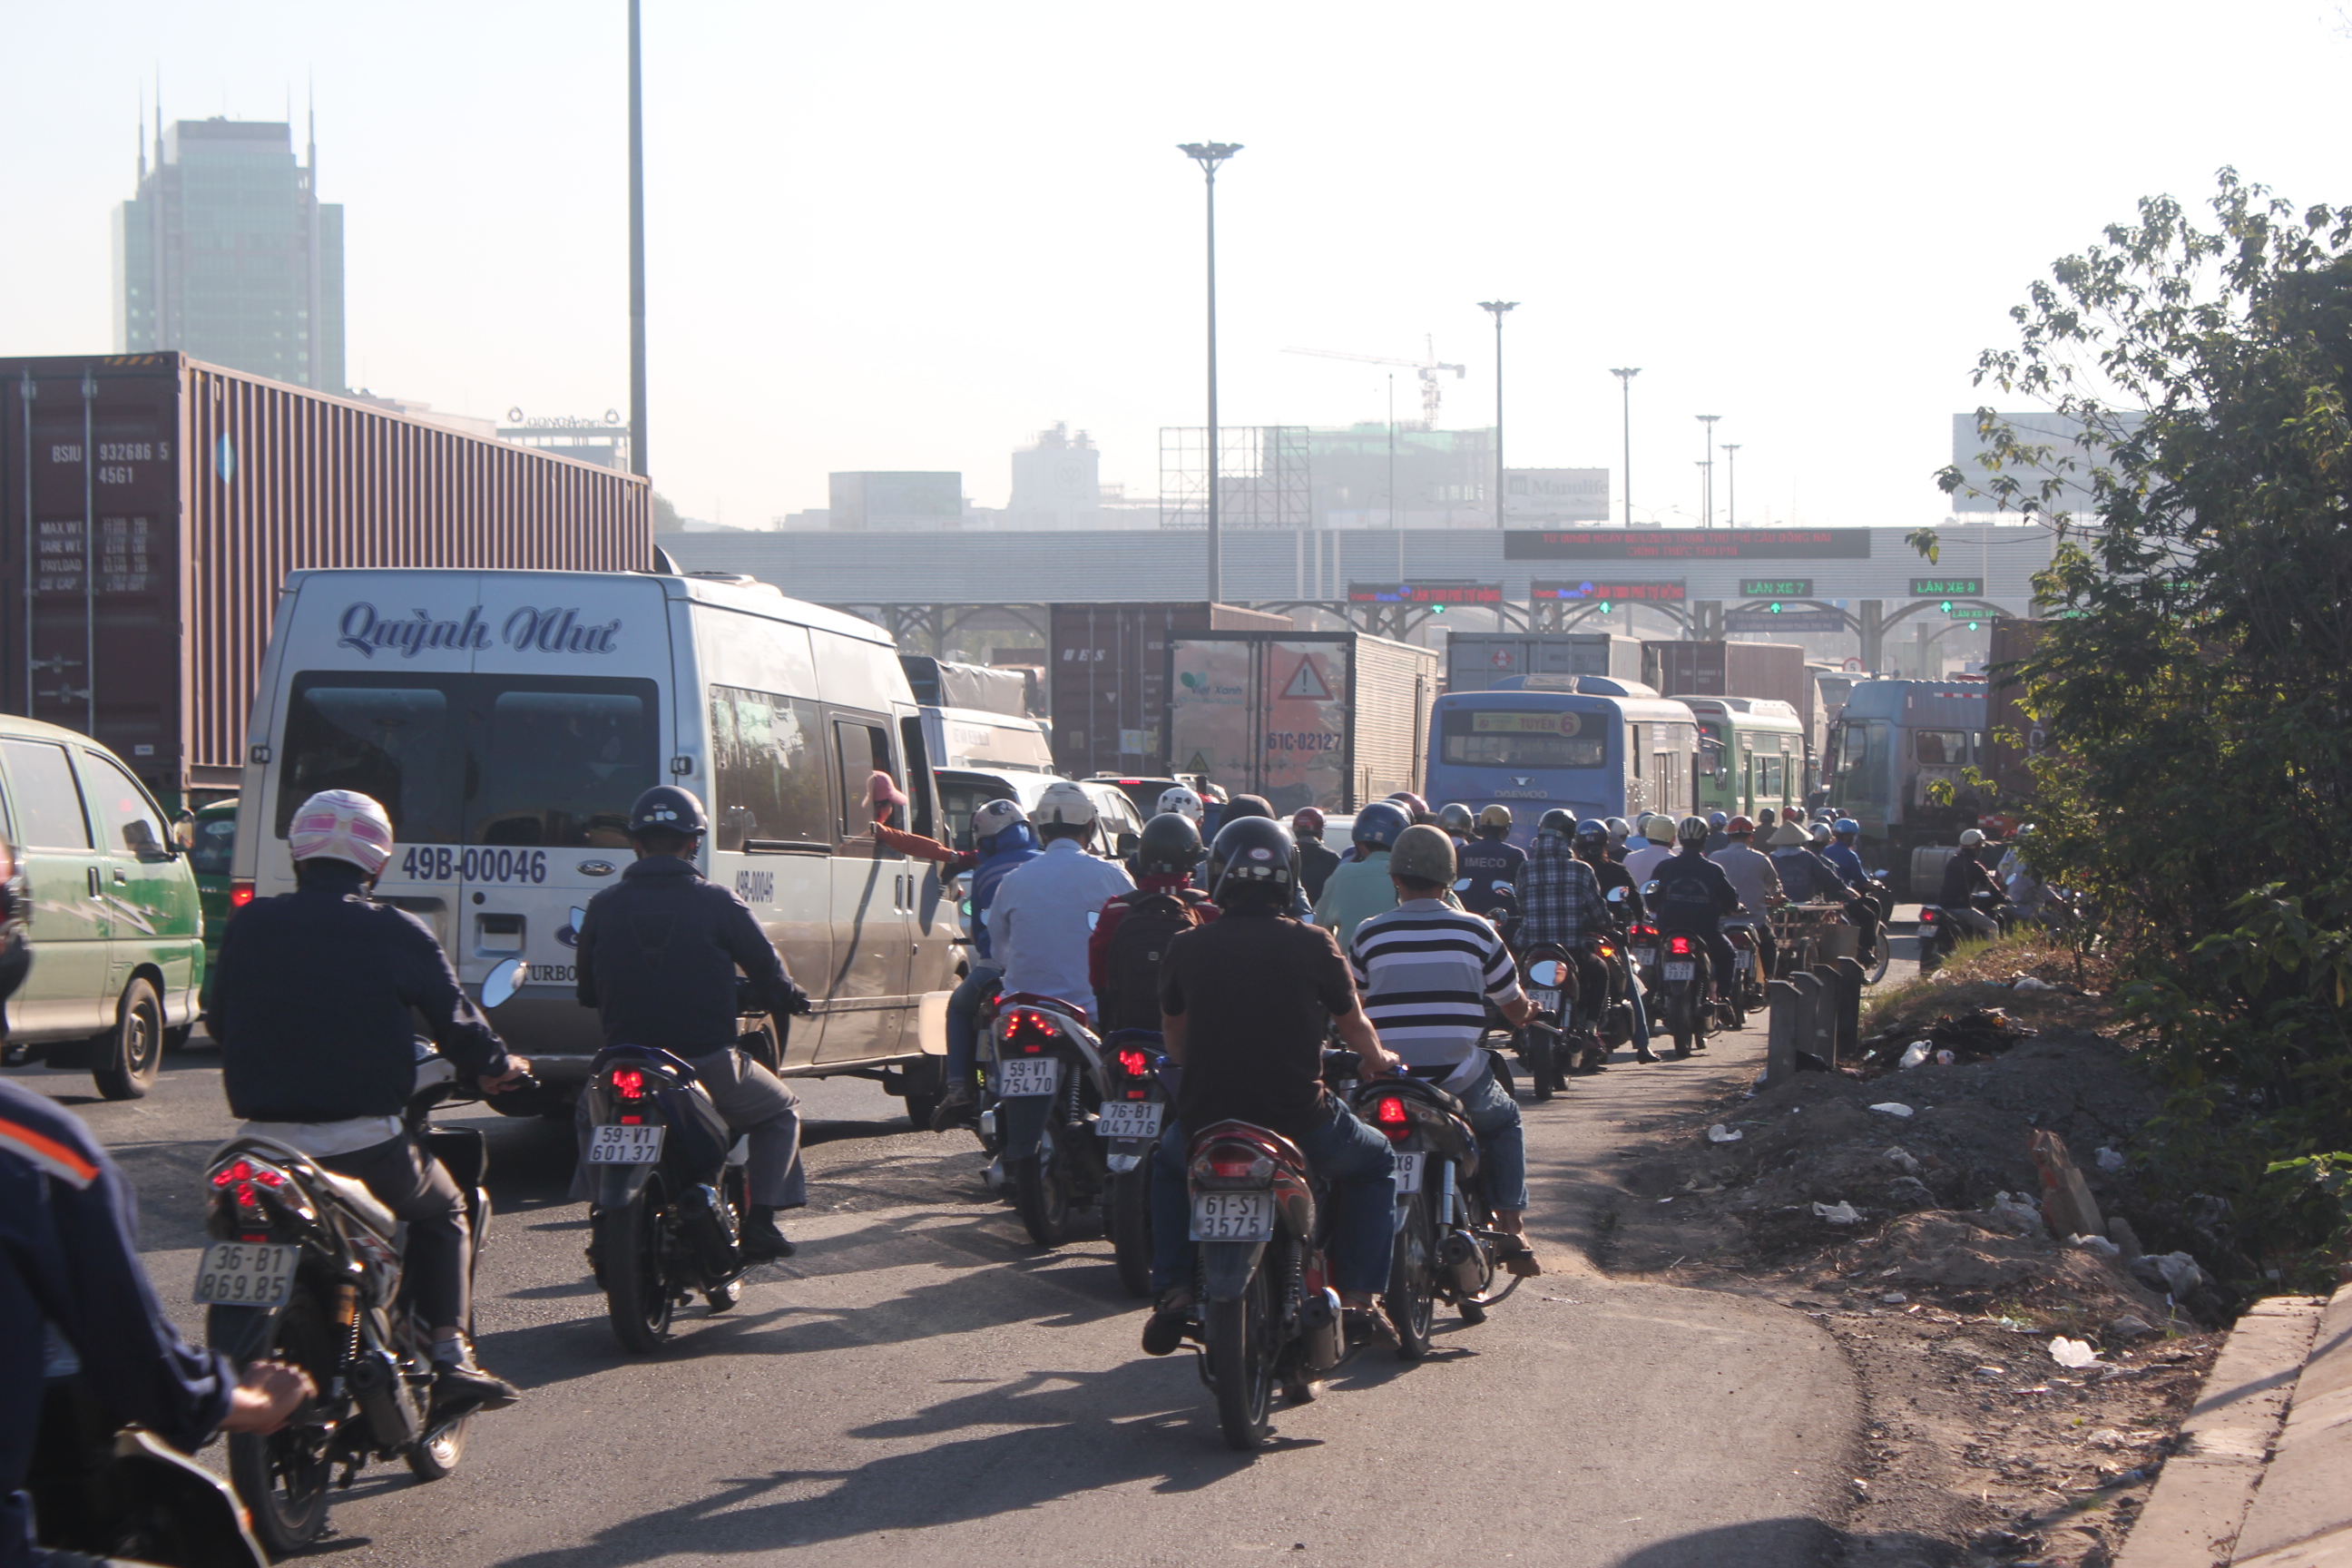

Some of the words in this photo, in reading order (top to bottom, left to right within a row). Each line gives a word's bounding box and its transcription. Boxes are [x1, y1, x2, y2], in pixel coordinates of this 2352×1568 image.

[52, 445, 82, 463] BSIU
[99, 443, 152, 461] 932686
[159, 442, 169, 460] 5
[99, 466, 133, 484] 45G1
[1532, 479, 1608, 495] Manulife
[1709, 534, 1729, 543] THU
[1732, 532, 1750, 543] PHÍ
[1813, 533, 1832, 543] NAI
[1696, 546, 1716, 556] THU
[1720, 544, 1738, 556] PHÍ
[40, 559, 83, 573] PAYLOAD
[1612, 586, 1629, 599] THU
[1776, 583, 1794, 593] XE
[1797, 583, 1805, 593] 7
[1946, 582, 1965, 593] XE
[1430, 590, 1446, 602] THU
[338, 601, 493, 660] Quỳnh
[503, 605, 622, 654] Như
[1215, 686, 1242, 695] Xanh
[1560, 715, 1574, 733] 6
[1268, 732, 1342, 750] 61C-02127
[1494, 790, 1548, 799] DAEWOO
[402, 847, 546, 884] 49B-00046
[1465, 858, 1507, 867] IMECO
[736, 870, 774, 903] 49B-00046
[1009, 1061, 1047, 1077] 59-V1
[1003, 1077, 1052, 1094] 754.70
[1110, 1104, 1152, 1119] 76-B1
[602, 1127, 651, 1143] 59-V1
[1101, 1121, 1155, 1134] 047.76
[592, 1145, 656, 1161] 601.37
[1205, 1196, 1260, 1215] 61-S1
[1204, 1217, 1260, 1237] 3575
[214, 1245, 283, 1272] 36-B1
[200, 1273, 286, 1301] 869.85
